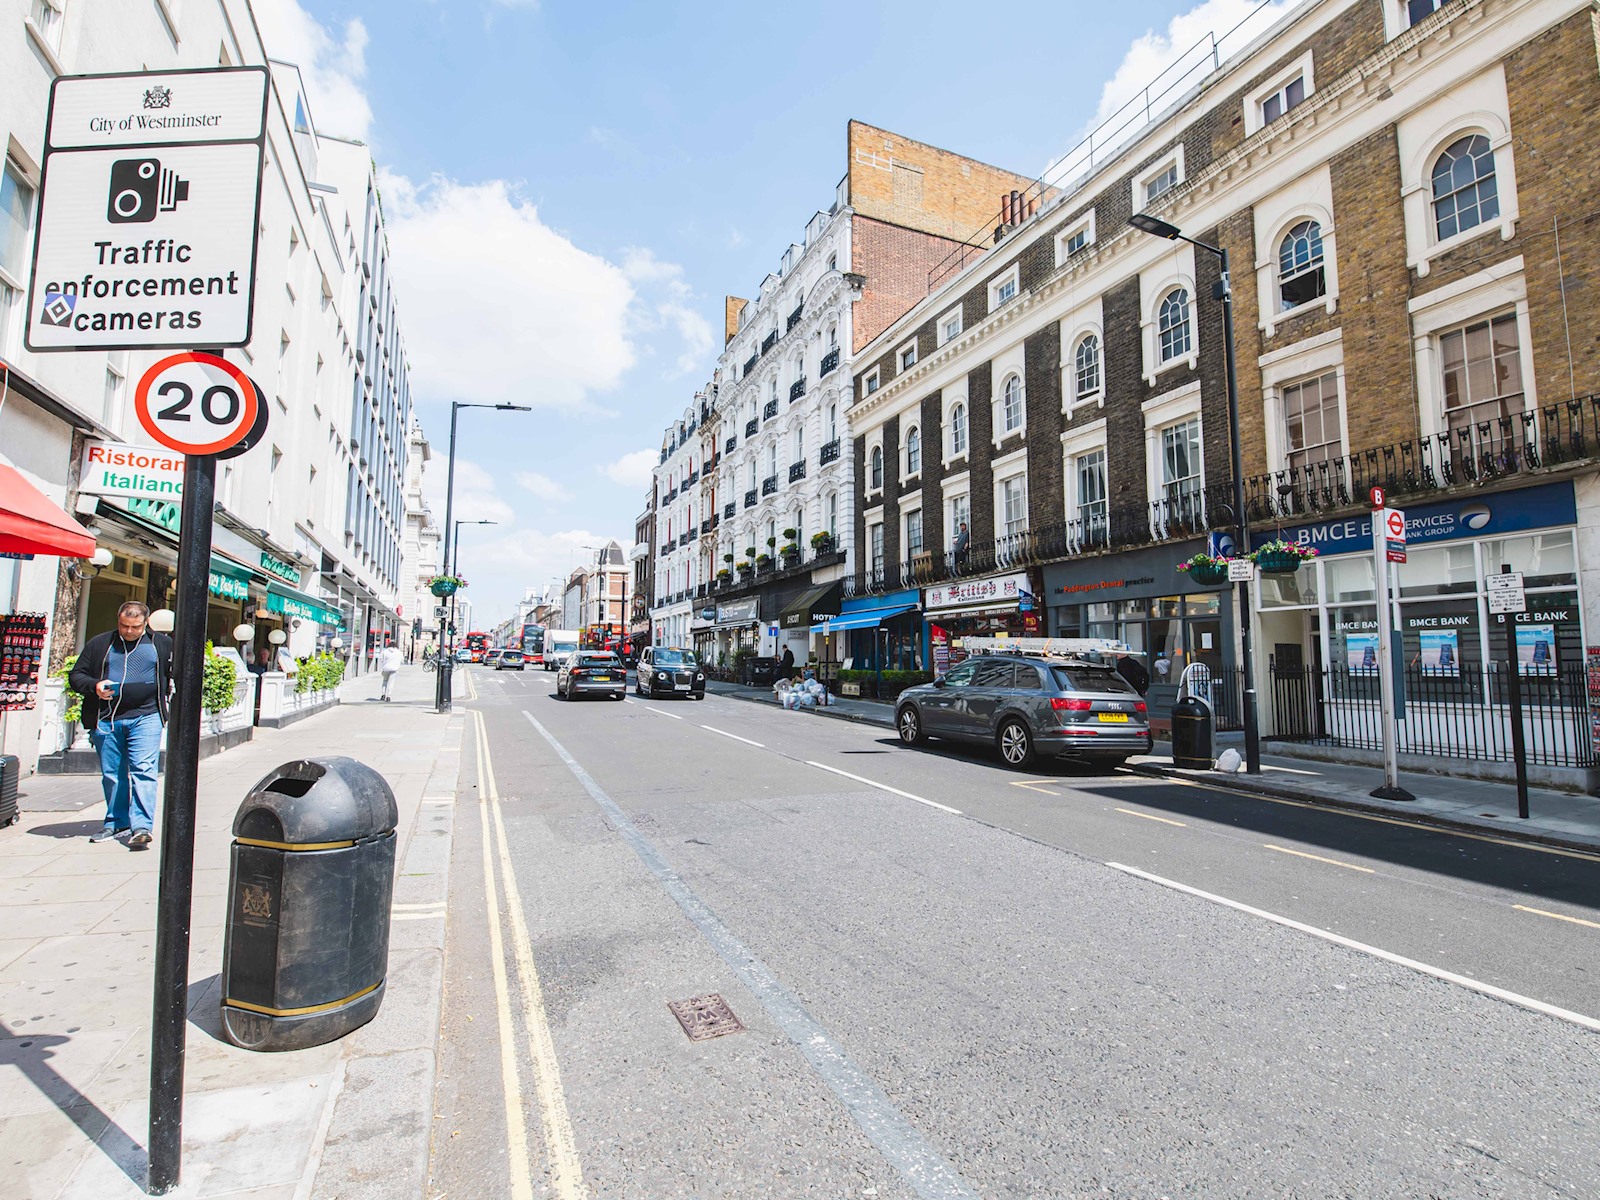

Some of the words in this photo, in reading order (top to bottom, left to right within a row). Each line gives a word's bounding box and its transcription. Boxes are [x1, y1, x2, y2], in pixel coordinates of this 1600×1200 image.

[90, 117, 116, 135] City
[119, 115, 134, 130] of
[136, 113, 222, 129] Westminster
[94, 239, 192, 265] Traffic
[45, 270, 239, 298] enforcement
[74, 310, 202, 332] cameras
[156, 381, 240, 425] 20
[88, 446, 186, 472] Ristoran
[1374, 489, 1382, 505] B
[1298, 521, 1357, 546] BMCE
[1406, 513, 1454, 530] ERVICES
[1406, 530, 1422, 539] ANK
[1424, 526, 1455, 536] GROUP
[948, 581, 996, 600] British
[1063, 584, 1099, 593] Paddington
[1100, 578, 1124, 589] Dental
[1125, 576, 1154, 588] practice
[1335, 621, 1360, 630] BMCE
[1361, 620, 1379, 629] BAN
[1410, 617, 1438, 627] BMCE
[1440, 616, 1470, 626] BANK
[1534, 611, 1569, 621] BANK
